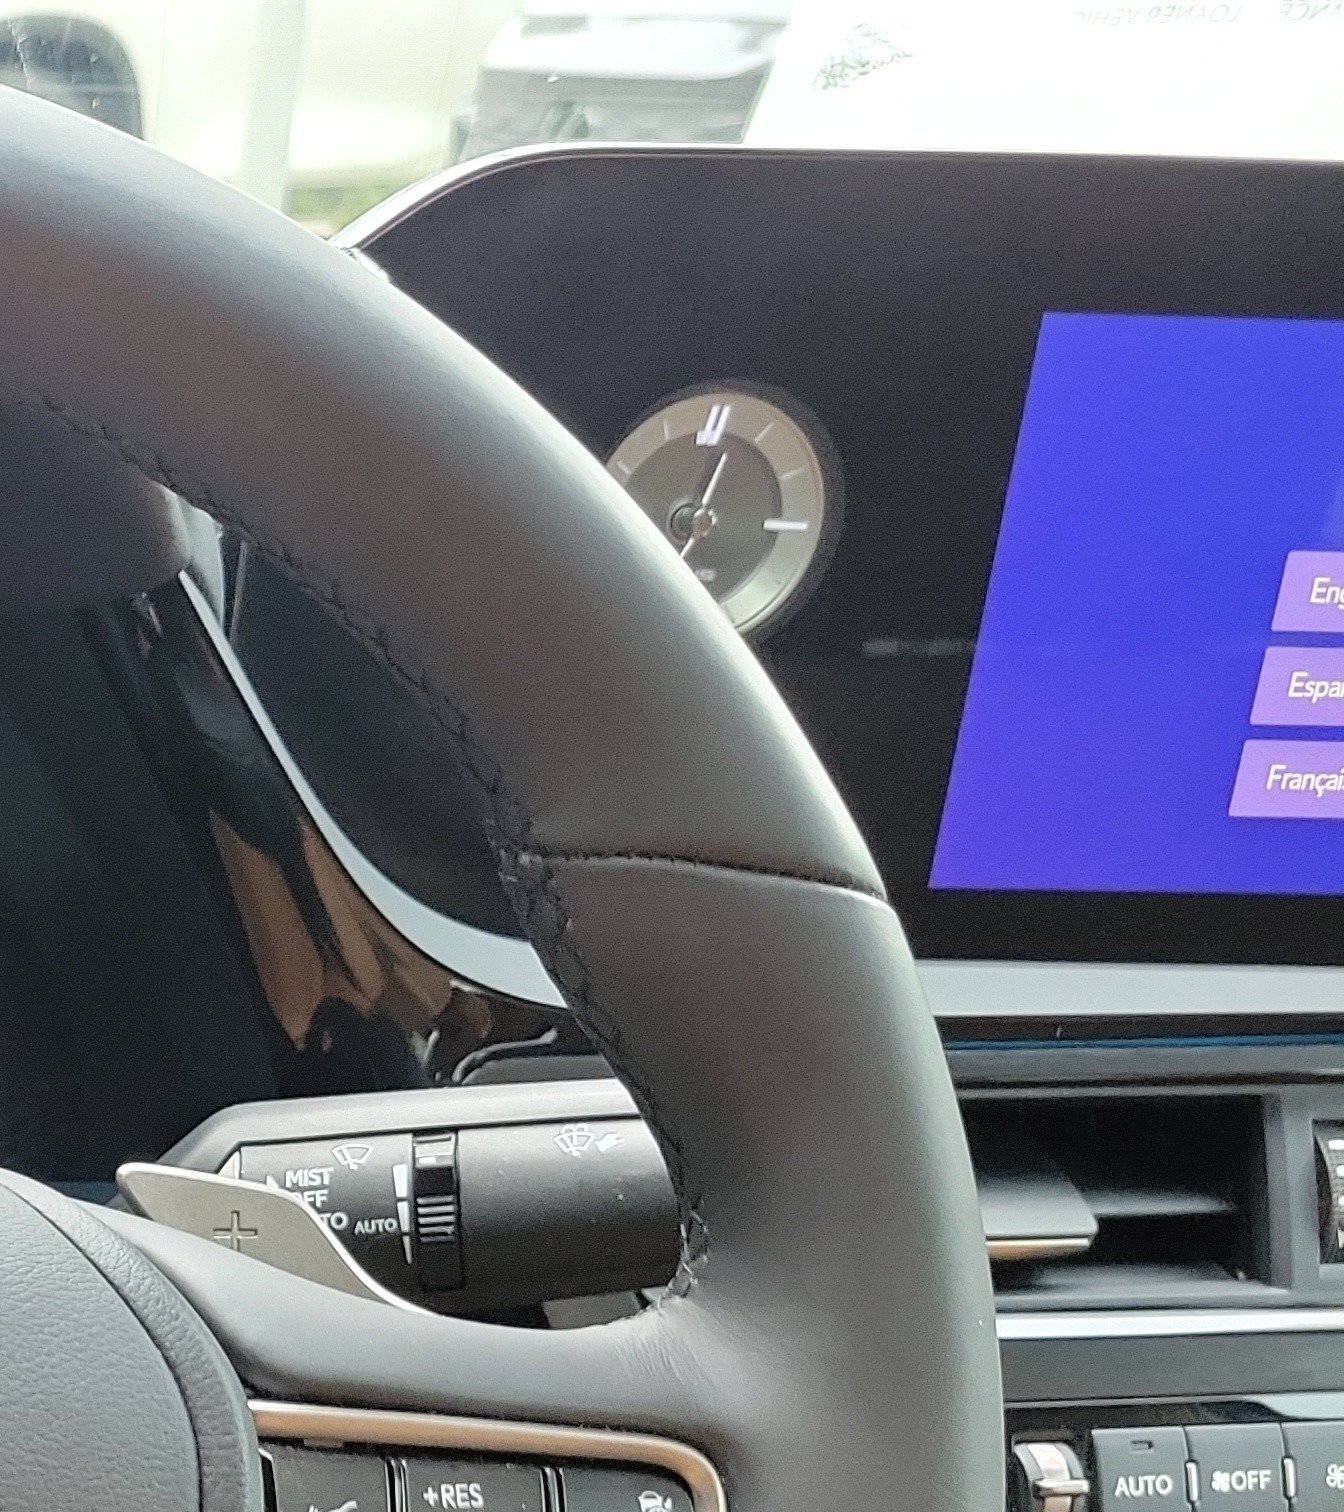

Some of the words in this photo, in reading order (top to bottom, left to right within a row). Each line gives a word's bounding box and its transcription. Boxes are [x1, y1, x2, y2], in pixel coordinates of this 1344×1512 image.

[285, 1167, 333, 1188] MIST
[353, 1217, 398, 1235] AUTO
[1114, 1474, 1173, 1497] AUTO
[1231, 1470, 1272, 1491] OFF
